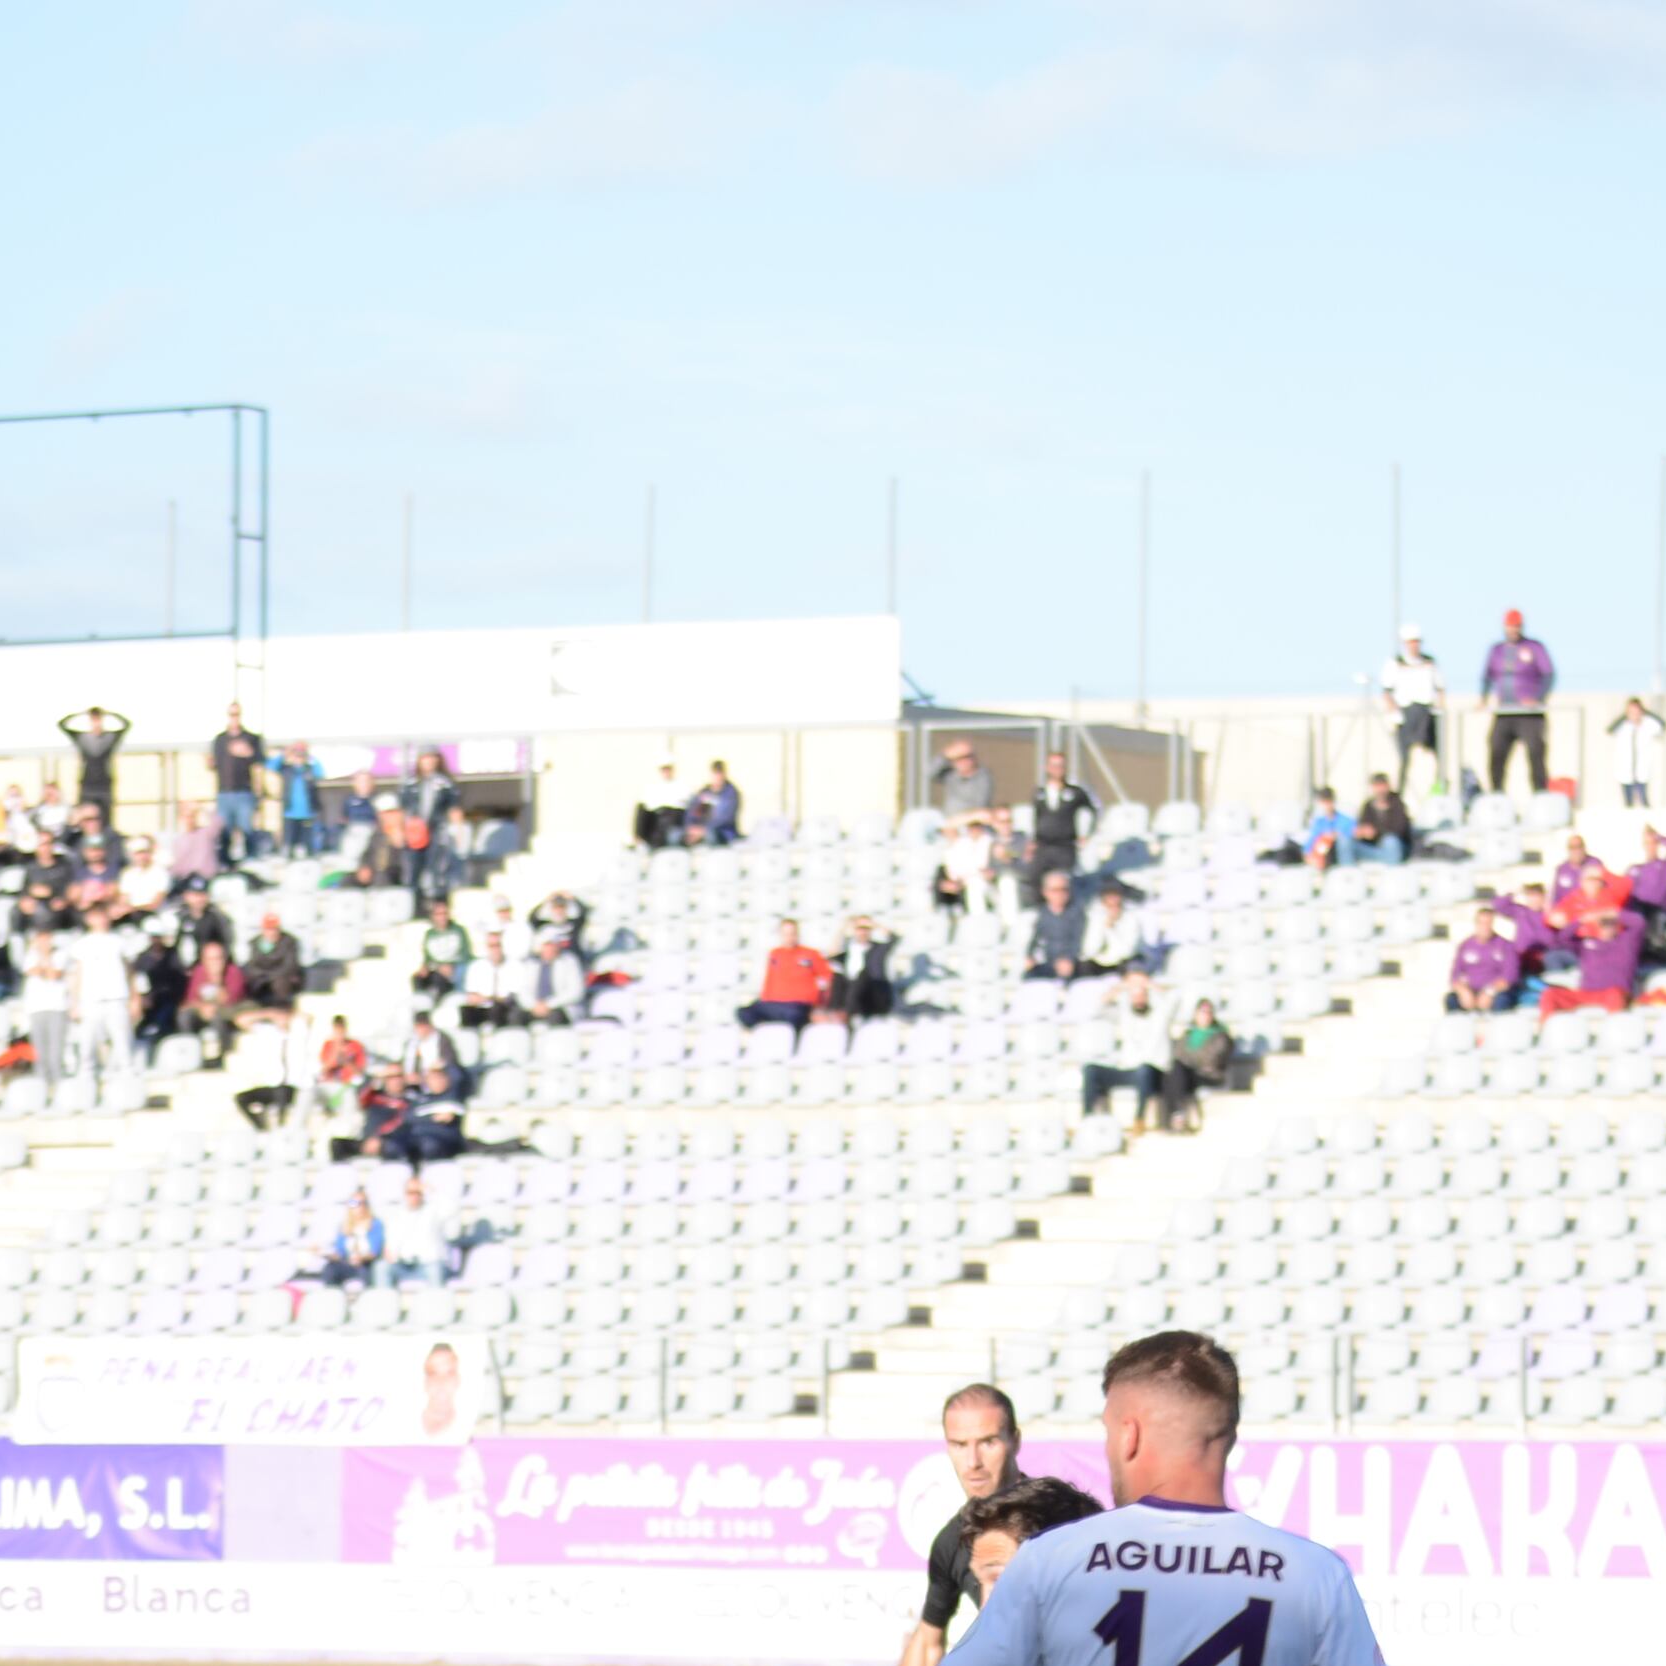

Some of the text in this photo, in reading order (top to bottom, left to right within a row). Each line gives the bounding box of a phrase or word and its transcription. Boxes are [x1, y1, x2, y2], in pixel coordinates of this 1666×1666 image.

[117, 1476, 212, 1530] S.L.
[1085, 1540, 1286, 1582] AGUILAR
[101, 1574, 252, 1615] Blanca
